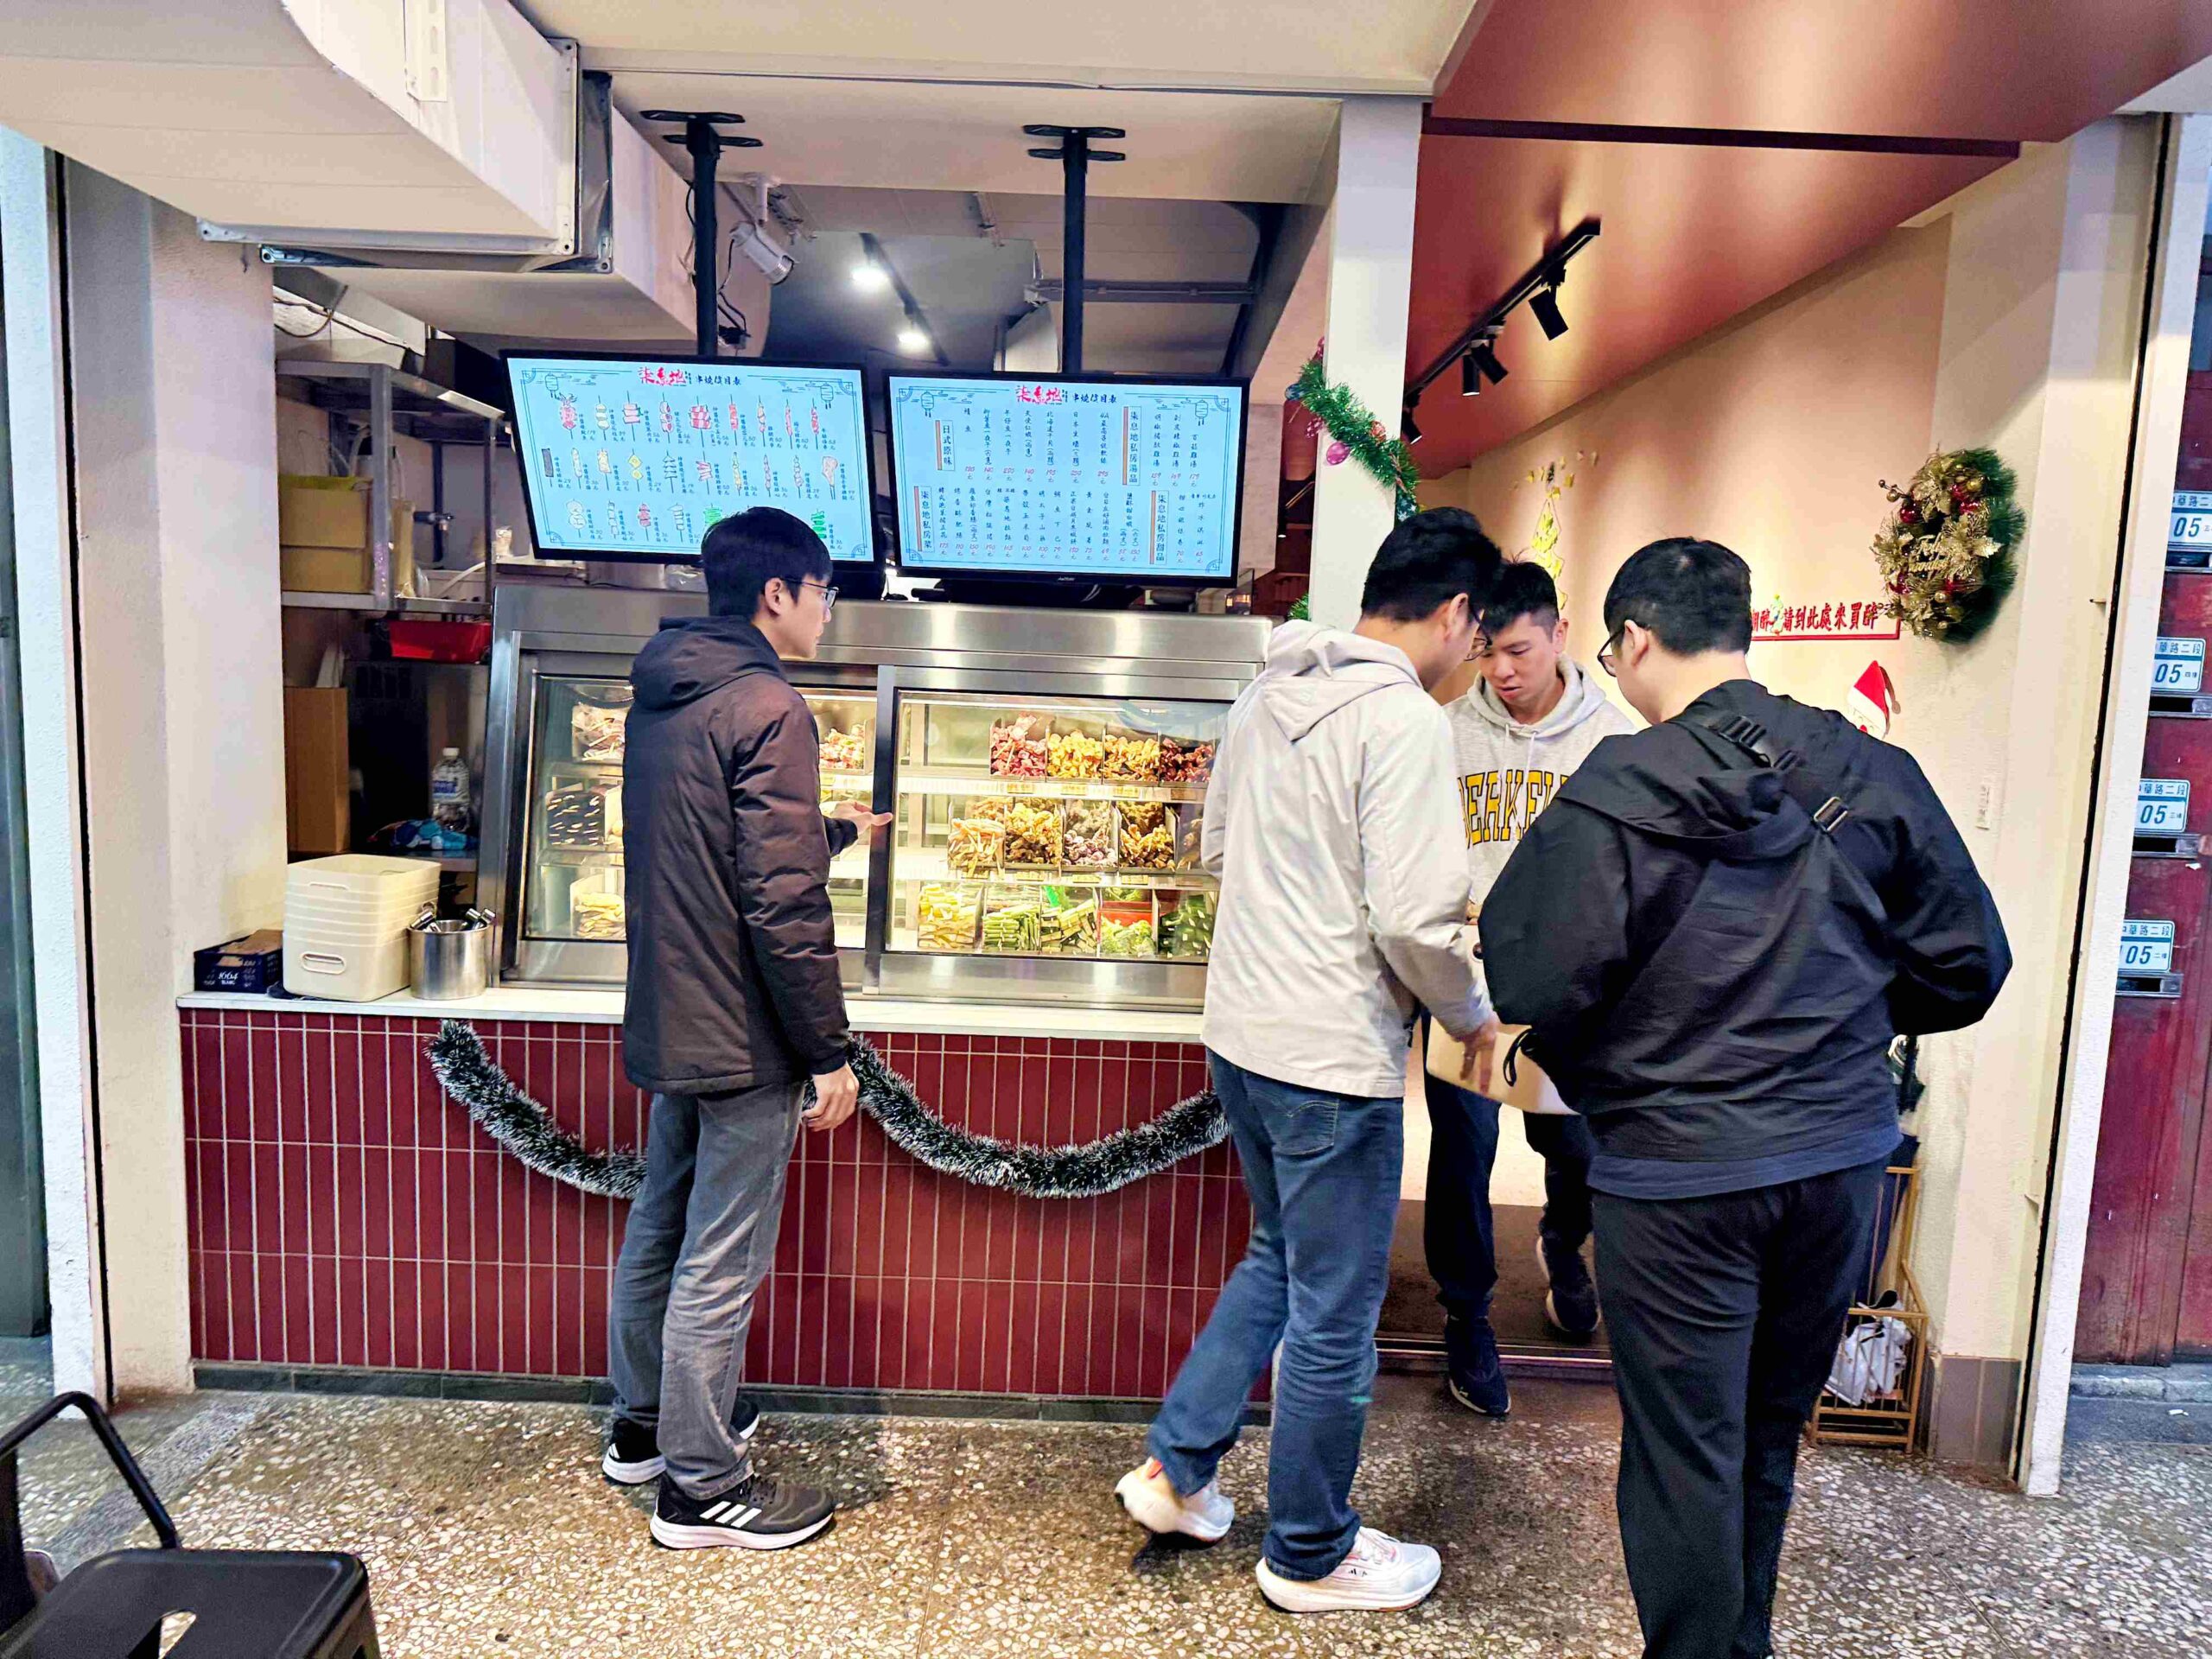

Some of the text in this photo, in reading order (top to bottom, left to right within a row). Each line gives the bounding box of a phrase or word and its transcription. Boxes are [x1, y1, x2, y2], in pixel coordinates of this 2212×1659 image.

[2173, 495, 2212, 507] 華路二
[2156, 642, 2201, 654] 華路二段
[2139, 784, 2185, 795] 華路二段
